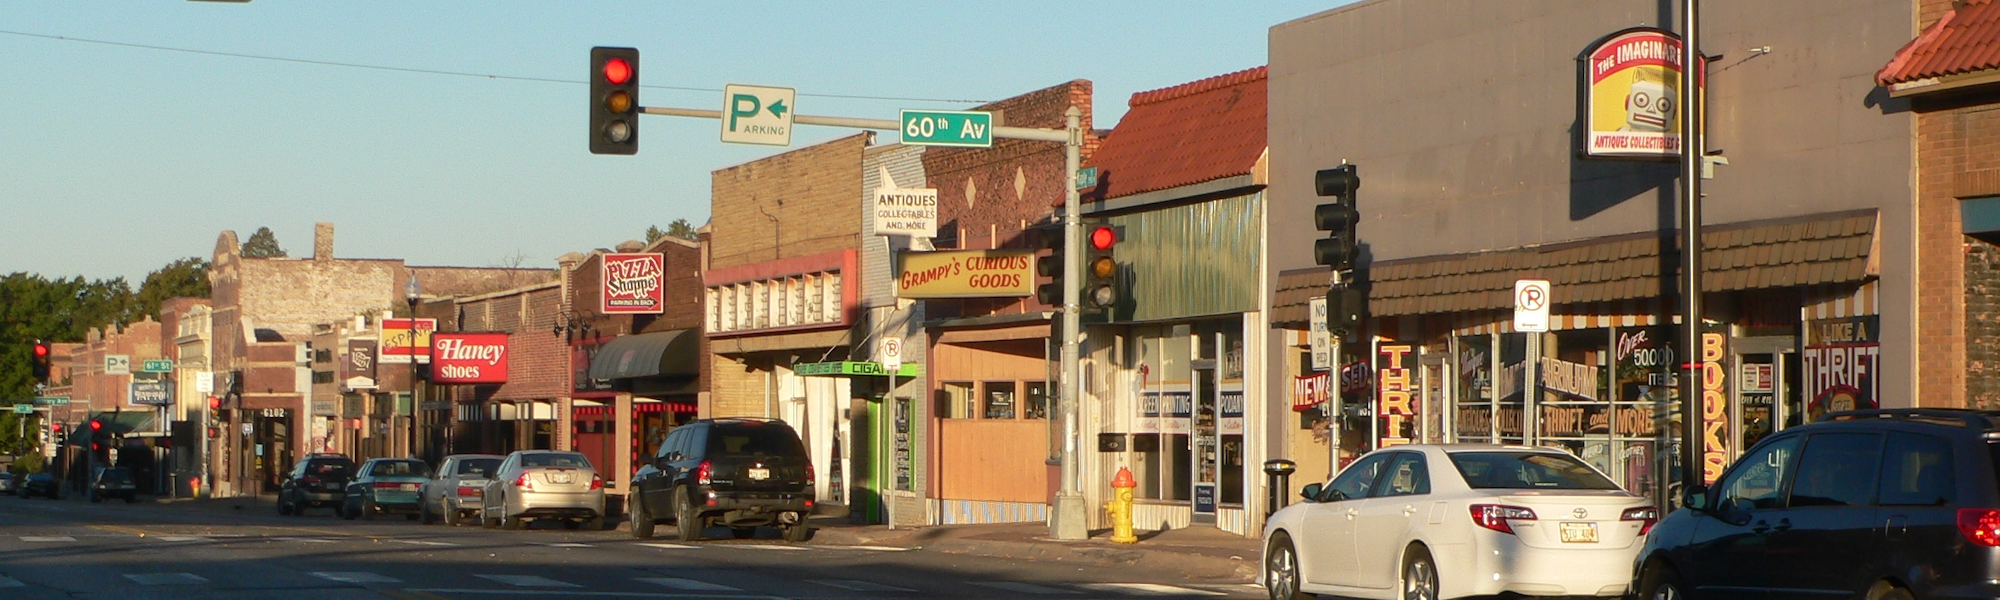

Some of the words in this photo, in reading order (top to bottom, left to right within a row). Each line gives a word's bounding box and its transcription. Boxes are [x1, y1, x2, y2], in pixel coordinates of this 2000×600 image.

[1597, 54, 1615, 75] THE
[1617, 40, 1681, 66] IMAGINARI
[906, 117, 949, 138] 60th
[960, 118, 985, 139] Av
[1594, 135, 1628, 149] ANTIQUES
[1630, 136, 1675, 150] COLLECTIBLES
[878, 194, 936, 208] ANTIQUES
[878, 208, 935, 220] COLLECTABLES
[906, 221, 926, 230] MORE
[605, 257, 661, 280] PIZZA
[902, 256, 961, 290] GRAMPY'S
[966, 256, 1028, 270] CURIOUS
[607, 277, 657, 298] Shoppe
[969, 273, 1021, 288] GOODS
[1315, 304, 1326, 318] NO
[1313, 322, 1327, 333] TUR
[1822, 323, 1853, 342] LIKE
[1856, 321, 1867, 341] A
[437, 338, 504, 366] Haney
[1317, 337, 1326, 348] ON
[441, 364, 480, 379] shoes
[1341, 362, 1368, 392] SED
[1805, 346, 1879, 404] THRIFT
[1137, 394, 1160, 413] SCREEN
[1162, 394, 1190, 413] PRINTING
[1380, 345, 1413, 449] THRI
[1702, 333, 1726, 482] BOOKS
[263, 408, 284, 418] 6102
[1545, 408, 1584, 433] THRIFT
[1589, 408, 1610, 427] and
[1616, 408, 1655, 433] MORE
